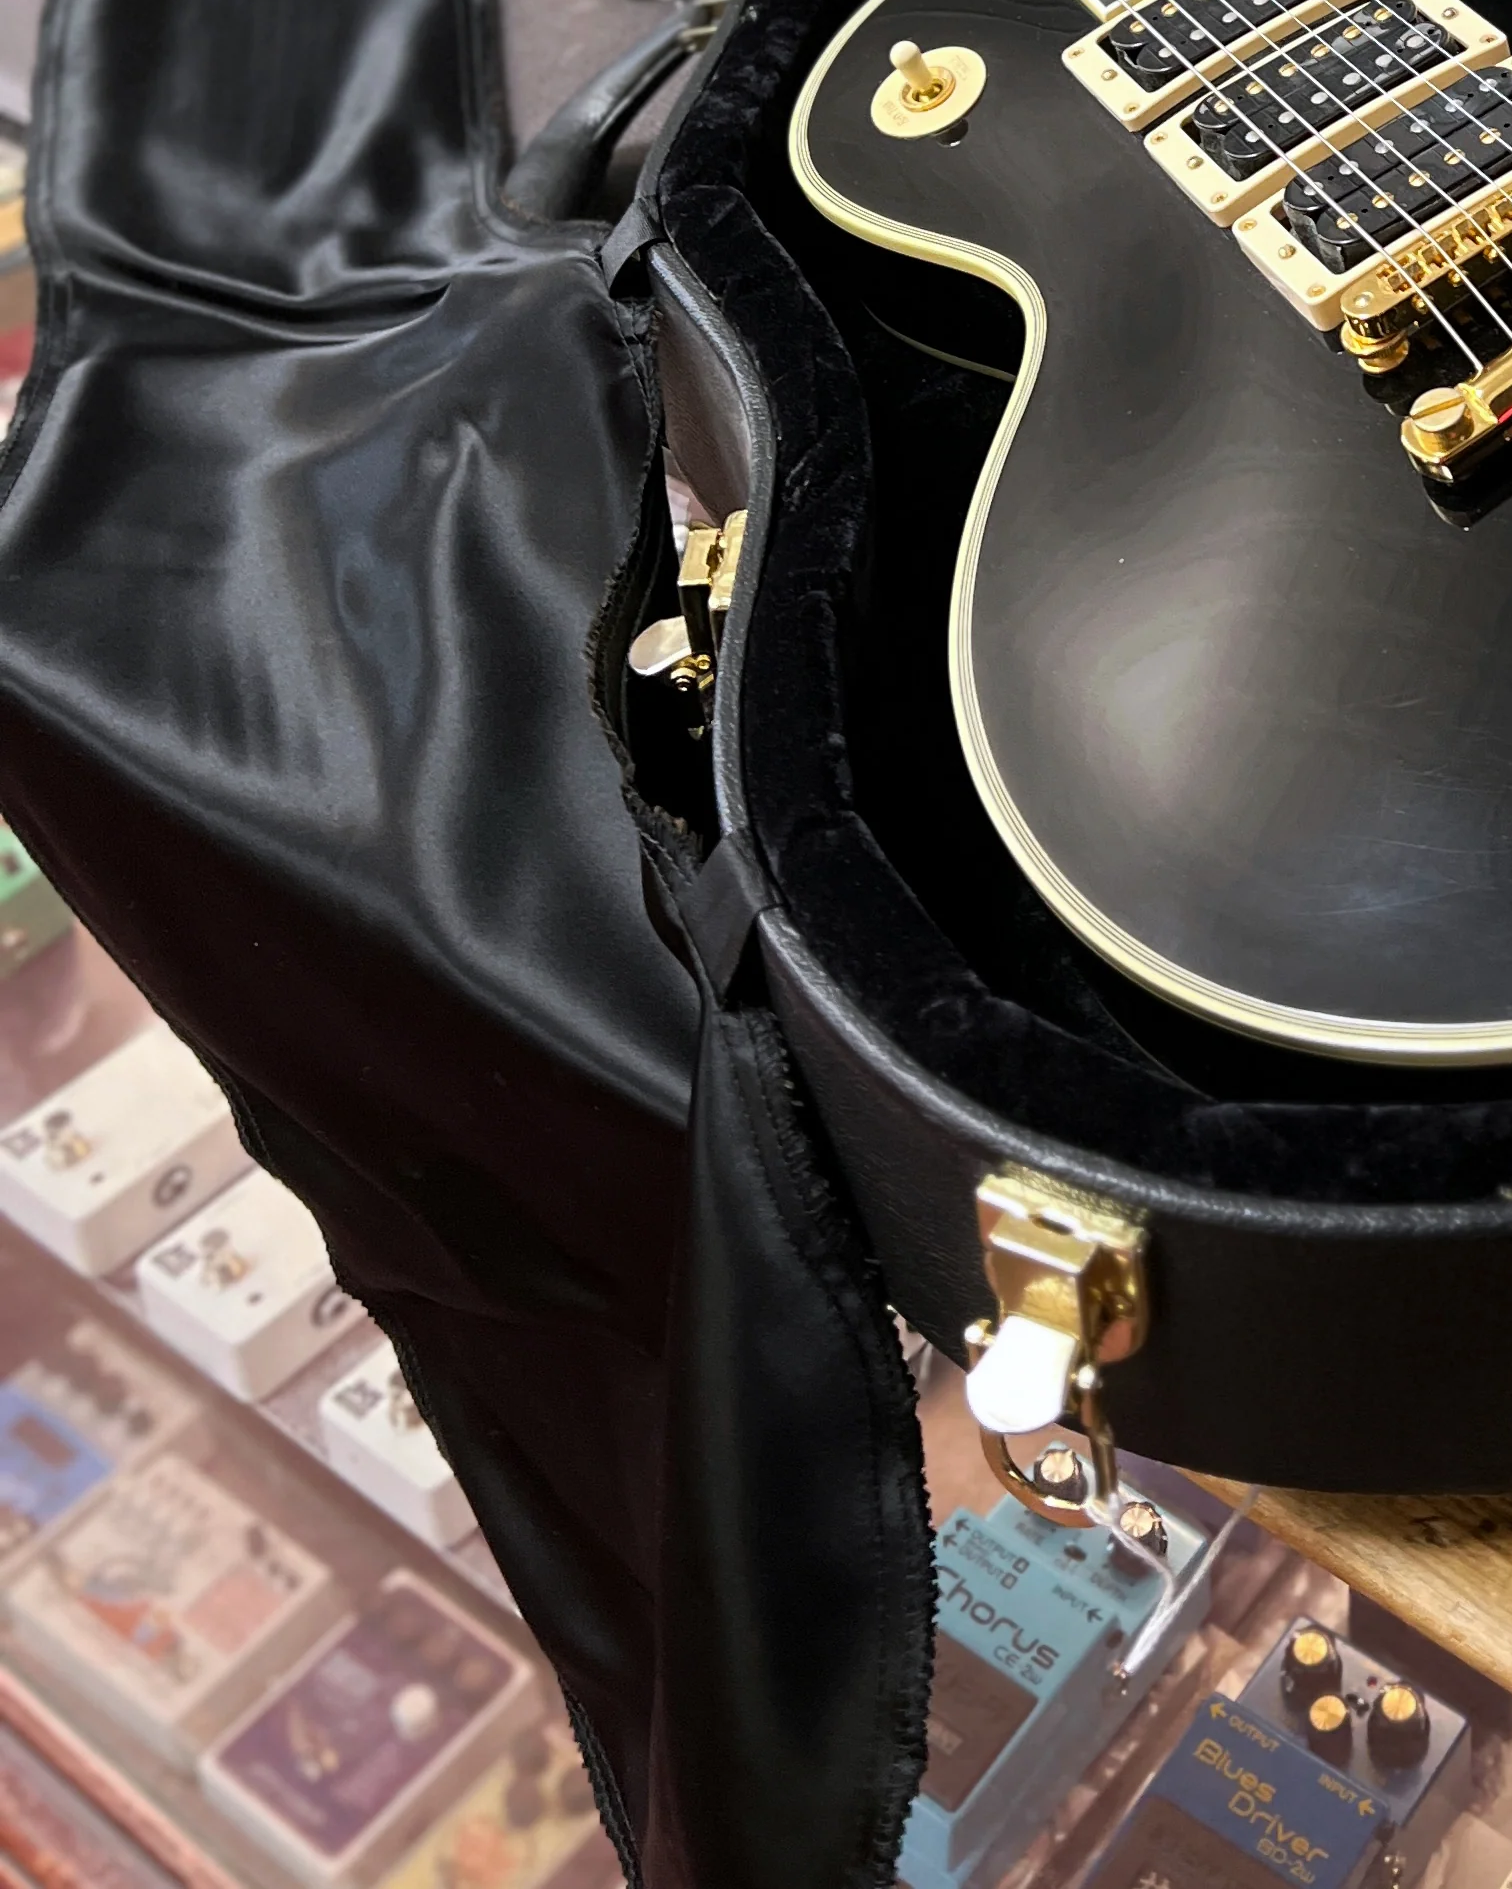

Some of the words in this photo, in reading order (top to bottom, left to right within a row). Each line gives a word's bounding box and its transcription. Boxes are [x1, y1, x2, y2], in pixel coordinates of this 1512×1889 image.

[1228, 1715, 1281, 1752] OUTPUT
[1193, 1737, 1276, 1803] Blues
[1317, 1774, 1358, 1803] INPUT
[1228, 1790, 1329, 1862] Driver
